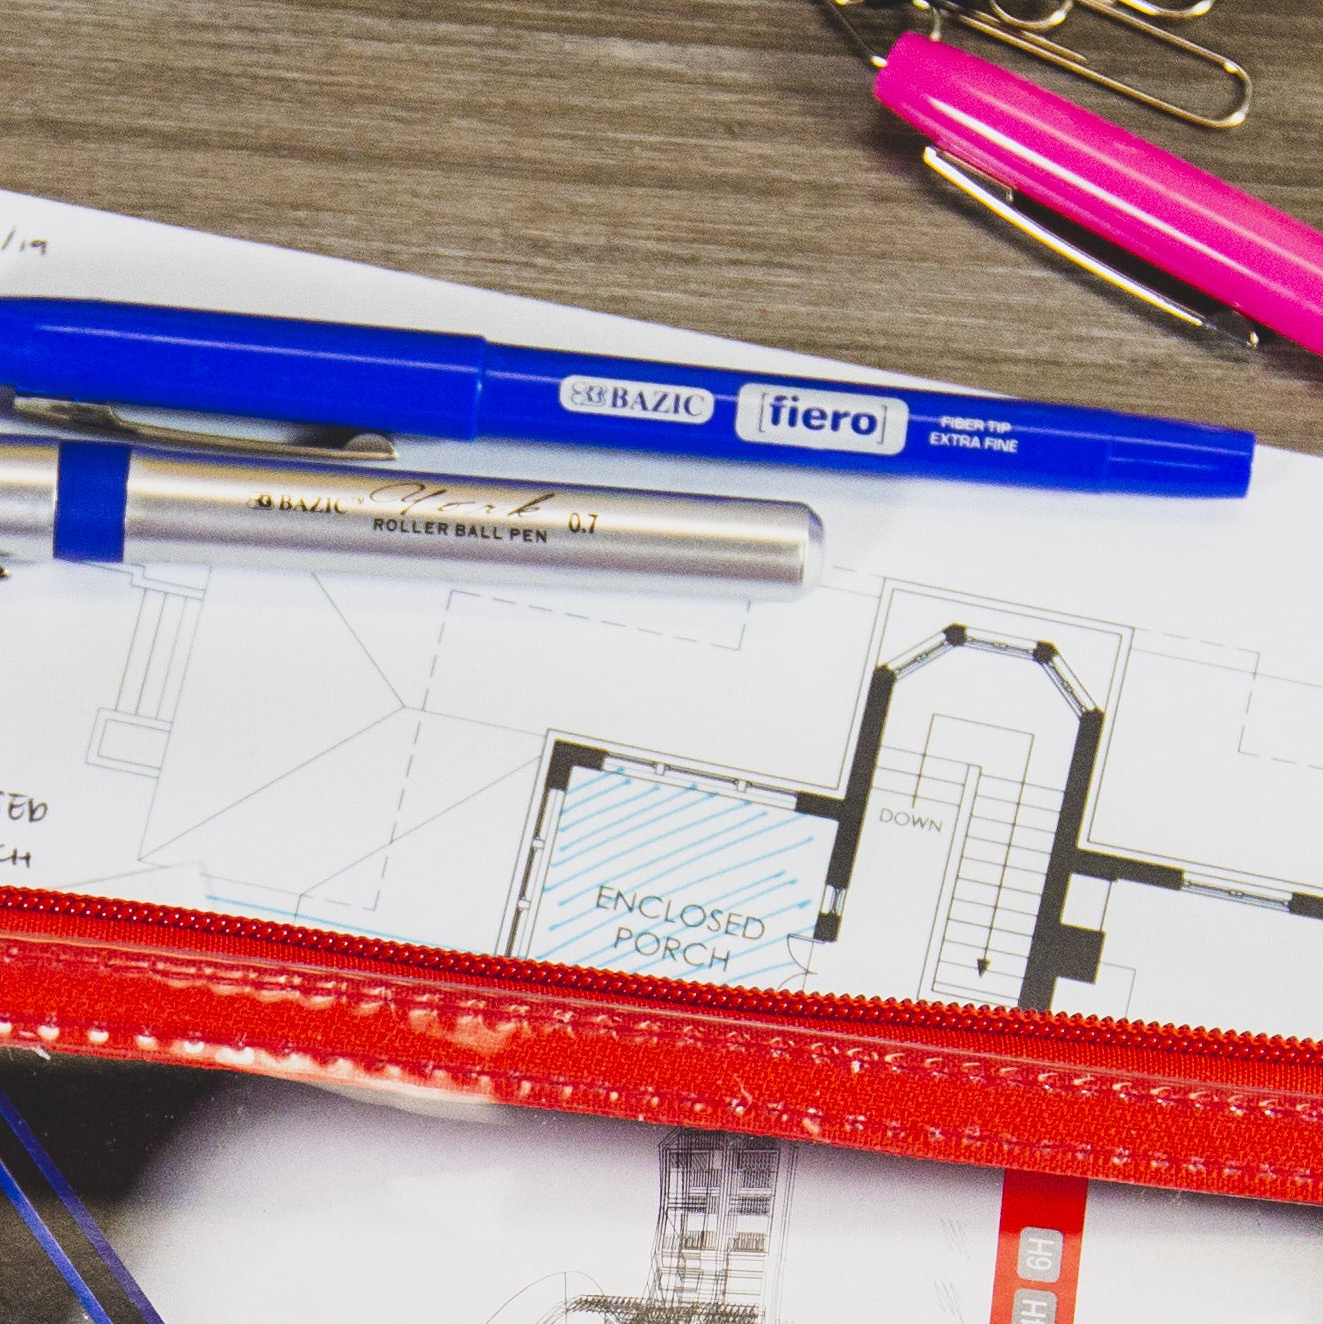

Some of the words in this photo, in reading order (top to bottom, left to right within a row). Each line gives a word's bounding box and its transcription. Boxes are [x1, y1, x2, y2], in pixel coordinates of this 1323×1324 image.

[609, 386, 705, 418] BAZIC
[929, 431, 981, 449] EXTRA
[984, 436, 1018, 454] FINE
[987, 420, 1012, 434] TIP
[279, 494, 347, 515] BAZIC
[568, 511, 599, 535] 0.7
[373, 517, 449, 537] ROLLER
[455, 522, 503, 541] BALL
[509, 528, 549, 544] PEN
[879, 807, 944, 833] DOWN
[595, 884, 766, 942] ENCLOSED
[613, 926, 732, 973] PORCH
[1026, 1237, 1055, 1271] 6H
